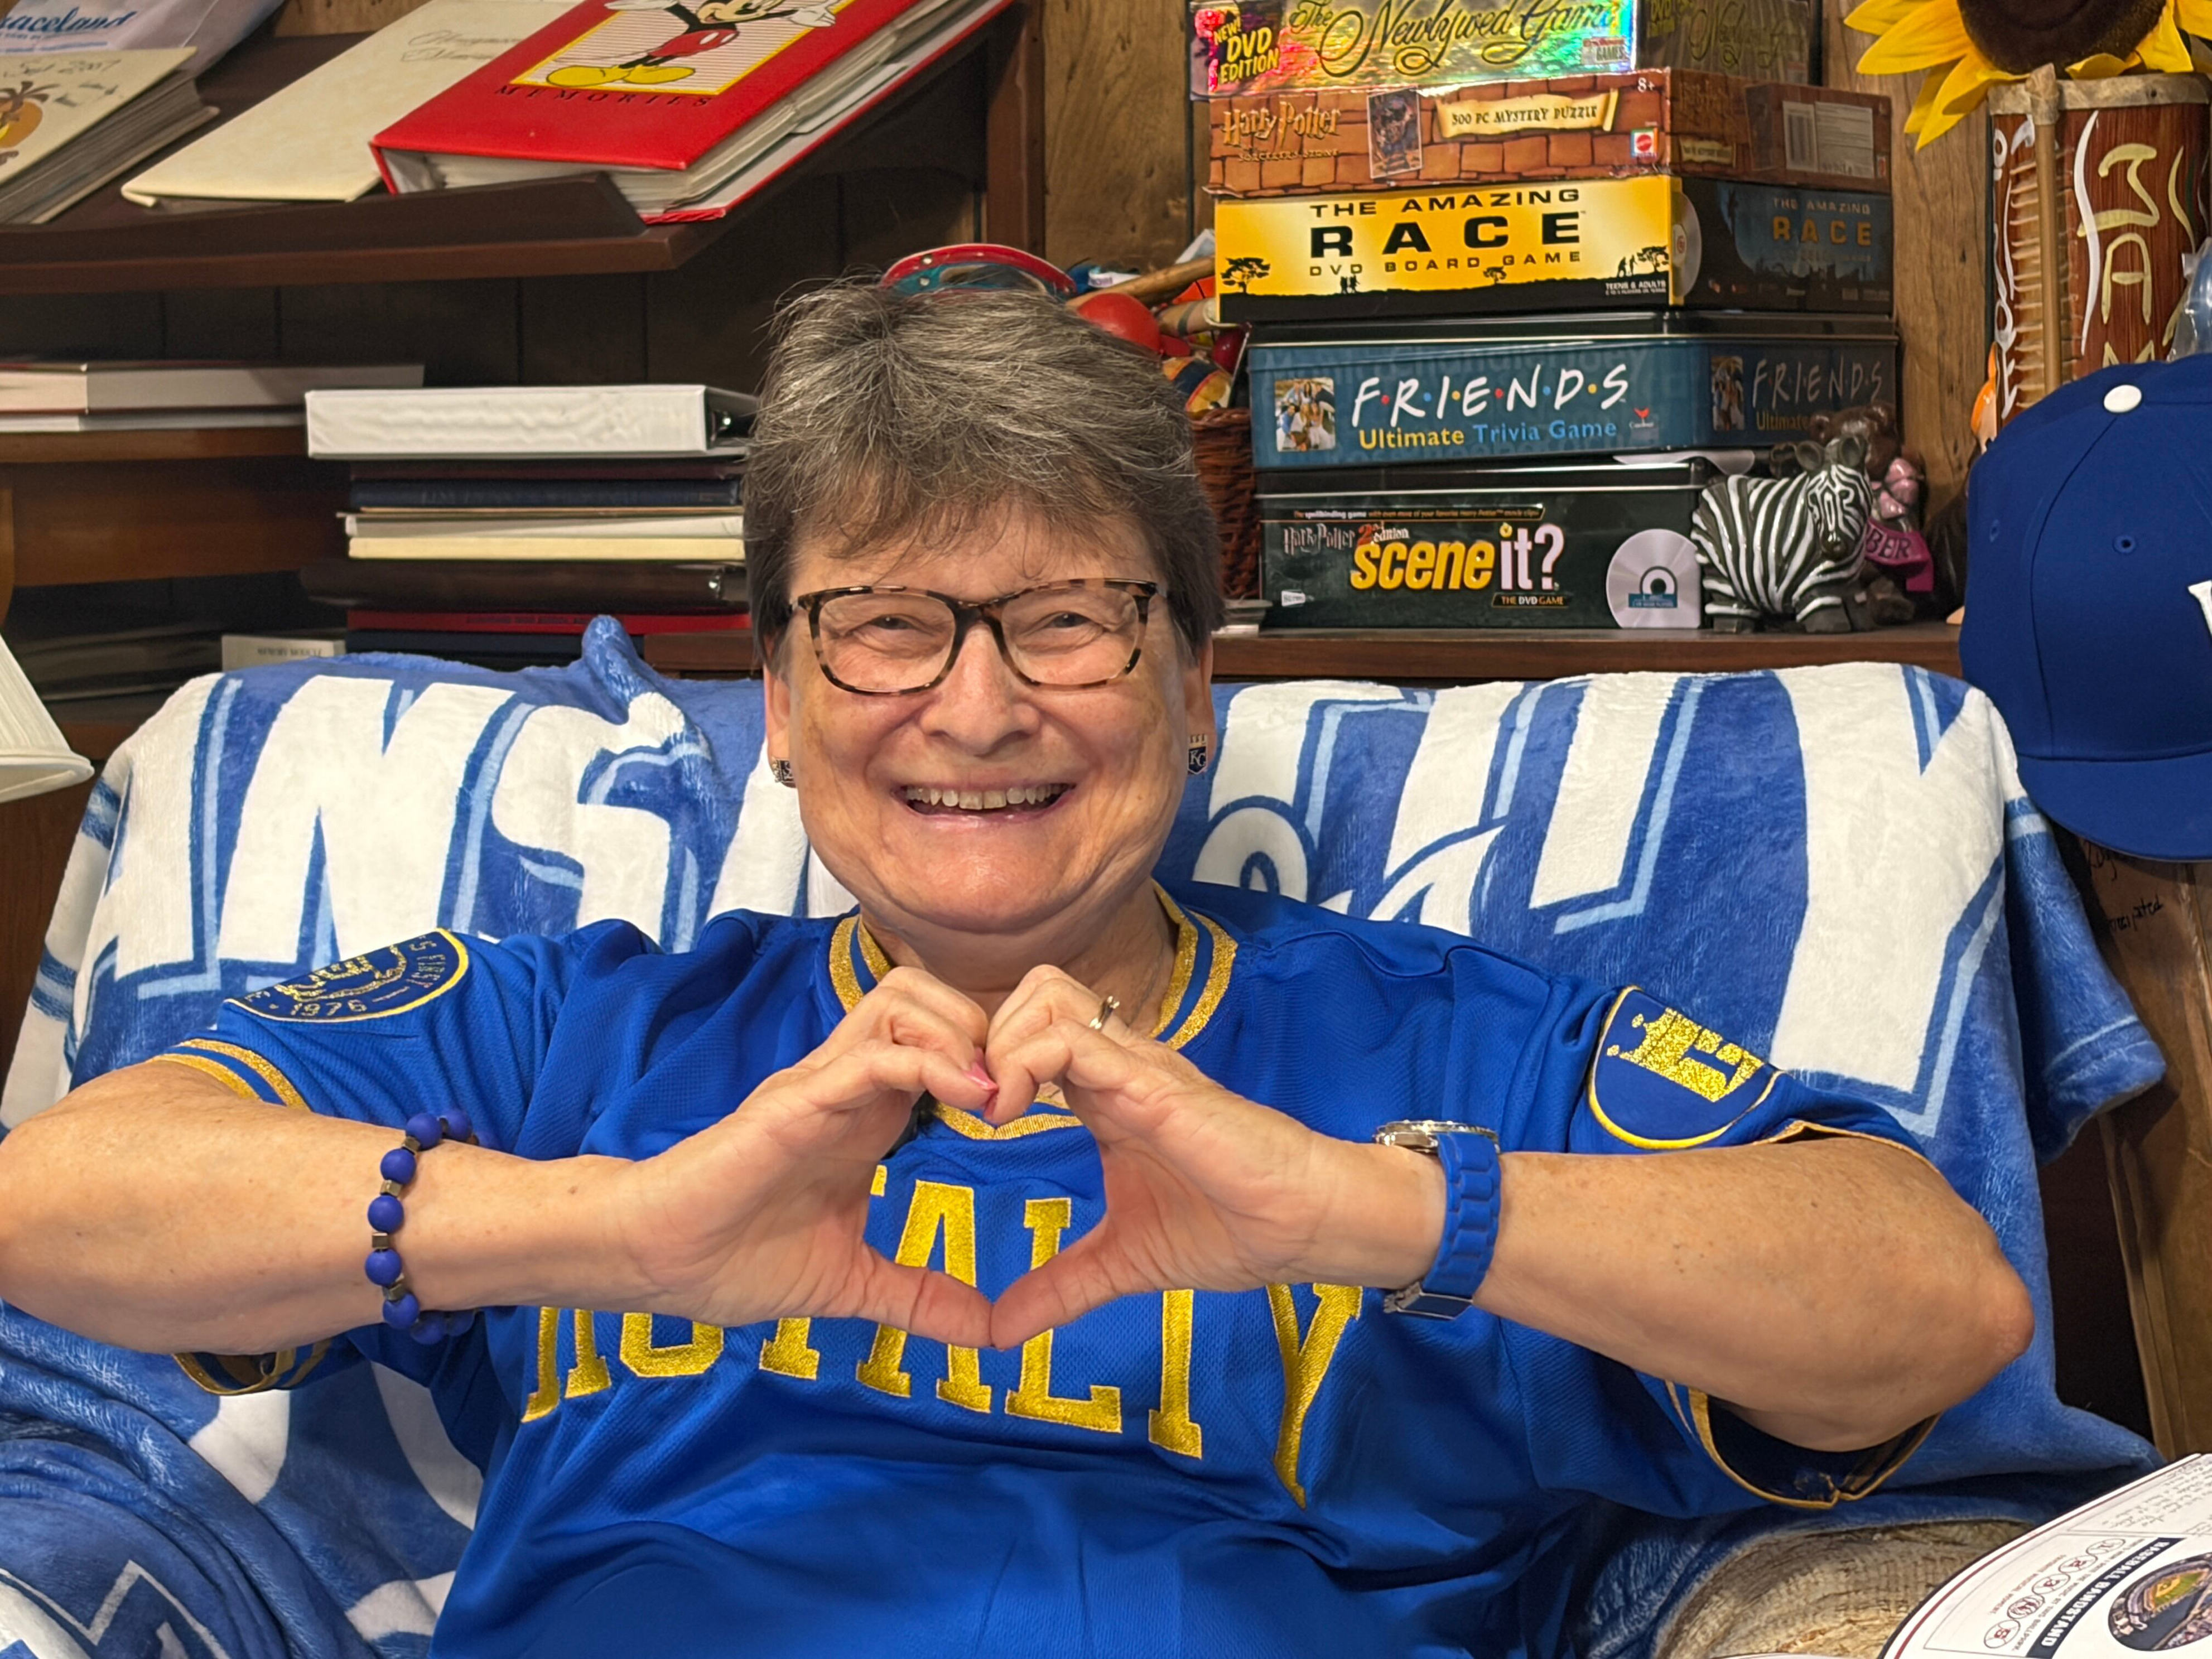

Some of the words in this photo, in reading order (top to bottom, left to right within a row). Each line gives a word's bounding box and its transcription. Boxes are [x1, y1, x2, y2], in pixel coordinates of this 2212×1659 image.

[0, 6, 137, 32] raceland
[1227, 27, 1273, 62] DVD
[1315, 0, 1510, 77] Newlywed
[1220, 49, 1279, 83] EDITION
[495, 85, 712, 108] MEMORIES
[1637, 78, 1655, 92] 8+
[1222, 108, 1277, 146] Harry
[1278, 101, 1341, 149] Potter
[1476, 113, 1490, 124] PC
[1493, 108, 1550, 123] MYSTERY
[1554, 105, 1598, 120] PUZZLE
[1310, 202, 1377, 218] THE
[1401, 188, 1580, 213] AMAZING
[1772, 197, 1798, 210] THE
[1806, 200, 1871, 216] AMAZING
[1310, 211, 1580, 258] RACE
[1772, 216, 1872, 247] RACE
[1309, 263, 1363, 277] DVD
[1385, 257, 1481, 273] BOARD
[1503, 251, 1582, 267] GAME
[1638, 279, 1666, 288] ADULTS
[1359, 427, 1464, 450] Ultimate
[1473, 422, 1540, 444] Trivia
[1548, 418, 1617, 440] Game
[1347, 511, 1367, 520] game
[1283, 526, 1317, 556] Harry
[1317, 523, 1356, 555] Potter
[1350, 541, 1496, 591] scene
[1499, 522, 1565, 591] it?
[1501, 596, 1516, 605] THE
[1518, 596, 1538, 605] DVD
[1539, 596, 1564, 605] GAME
[289, 999, 368, 1017] 1976
[2104, 1541, 2170, 1580] BASEBALL
[2041, 1581, 2111, 1647] BANDSTAND
